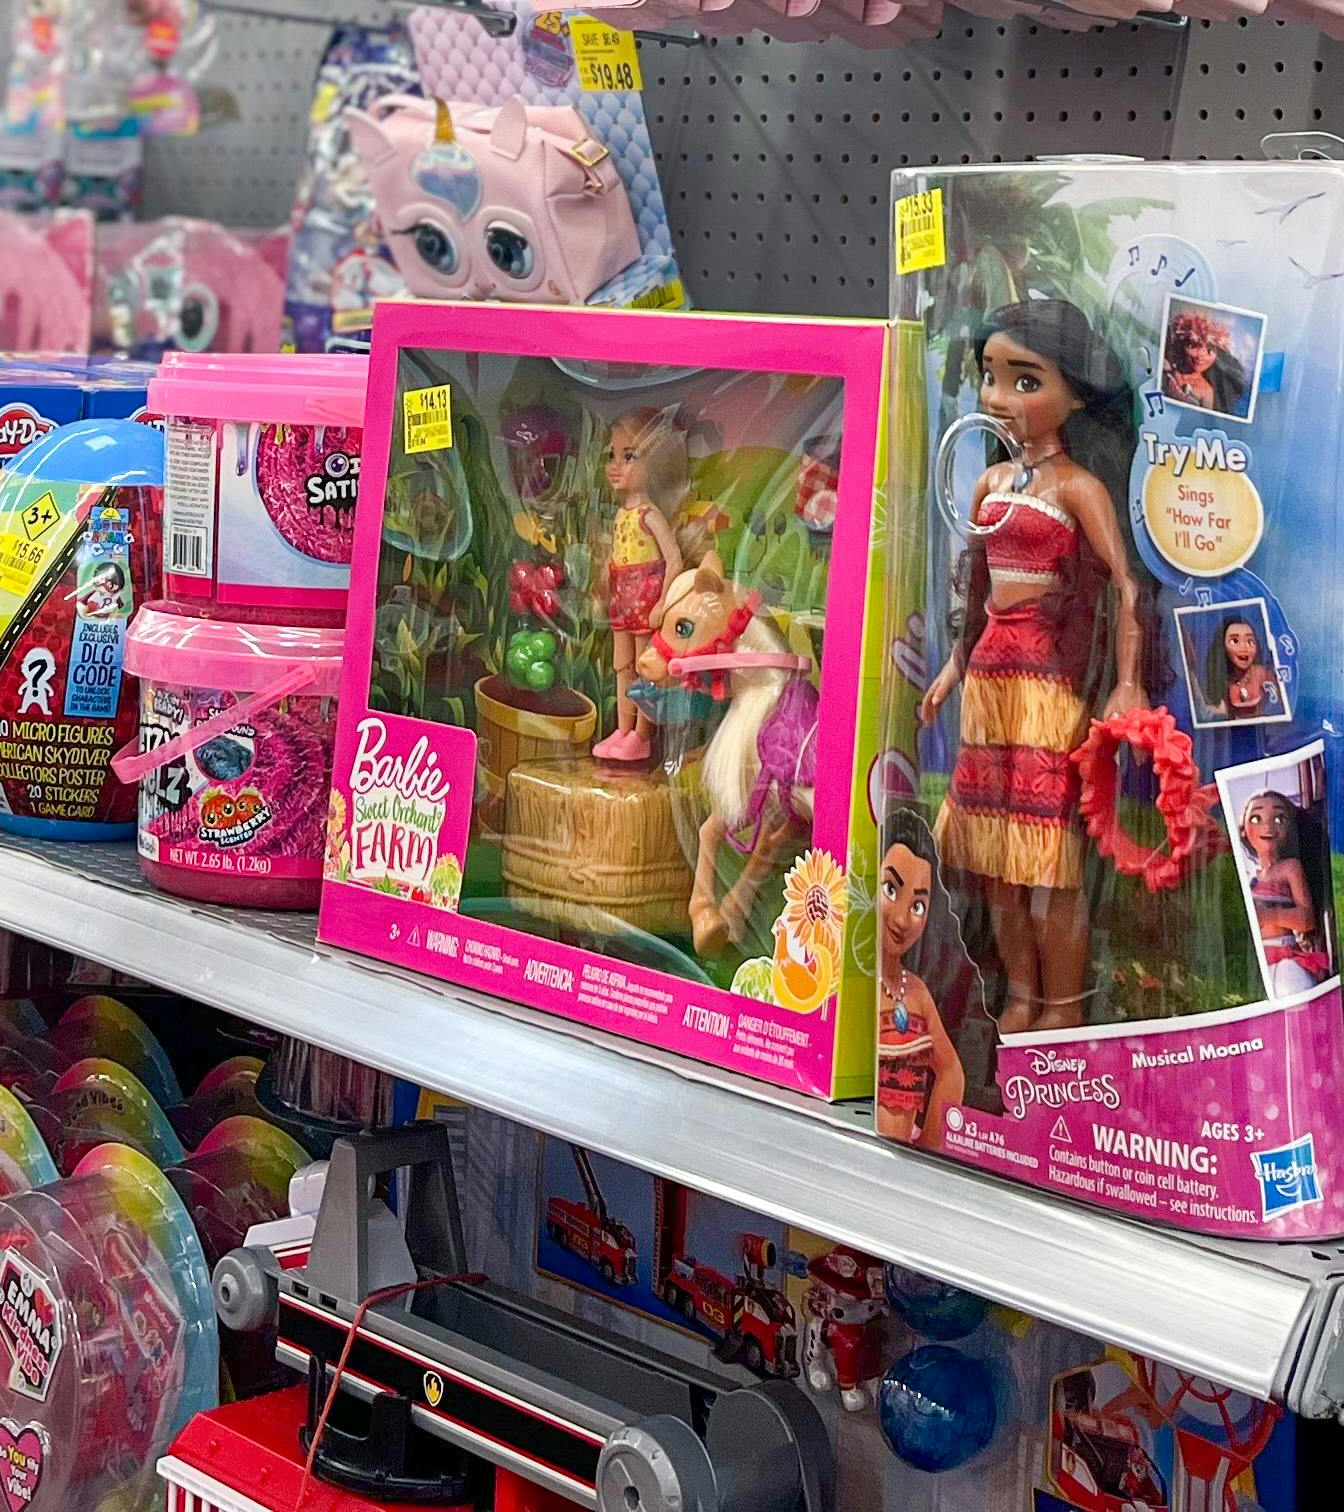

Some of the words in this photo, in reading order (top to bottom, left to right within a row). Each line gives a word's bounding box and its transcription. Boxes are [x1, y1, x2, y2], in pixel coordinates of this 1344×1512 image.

[590, 62, 634, 91] $19.48
[419, 388, 447, 411] $14.13
[1141, 431, 1191, 477] Try
[1194, 436, 1248, 473] Me
[1177, 484, 1215, 508] Sings
[27, 506, 53, 525] 3+
[1166, 506, 1204, 526] "How
[1207, 511, 1232, 529] Far
[12, 536, 45, 564] $15.66
[1174, 530, 1191, 549] I'll
[1194, 534, 1223, 552] Go"
[81, 642, 114, 666] DLC
[72, 664, 118, 688] CODE
[11, 720, 57, 743] MICRO
[57, 724, 115, 747] FIGURES
[44, 745, 111, 767] SKYDIVER
[349, 717, 451, 803] Barbie
[58, 768, 106, 786] POSTER
[26, 783, 42, 799] 20
[44, 784, 99, 804] STICKERS
[38, 801, 66, 816] GAME
[67, 802, 96, 818] CARD
[199, 805, 272, 839] STRAWBERRY
[355, 795, 391, 824] Sweet
[392, 793, 442, 836] Orchard
[169, 848, 183, 864] NET
[184, 850, 200, 866] WT.
[201, 852, 221, 869] 2.65
[222, 855, 235, 870] lb.
[236, 856, 272, 874] (1.2kg)
[355, 821, 434, 881] FARM
[1131, 1044, 1195, 1069] Musical
[1199, 1037, 1264, 1062] Moana
[1005, 1073, 1121, 1120] PRINCESS
[1200, 1120, 1241, 1142] AGES
[1243, 1124, 1265, 1143] 3+
[1091, 1122, 1219, 1176] WARNING:
[1048, 1144, 1088, 1170] Contains
[1088, 1153, 1122, 1178] button
[1122, 1167, 1134, 1181] or
[1134, 1169, 1156, 1187] coin
[1157, 1172, 1176, 1192] cell
[1176, 1175, 1220, 1201] battery.
[1261, 1160, 1316, 1184] Hasbro
[1047, 1166, 1096, 1193] Hazardous
[1096, 1176, 1106, 1196] if
[1105, 1182, 1158, 1208] swallowed
[1169, 1197, 1189, 1213] see
[1189, 1199, 1259, 1224] instructions.
[7, 1279, 50, 1355] EMMA
[701, 1300, 726, 1325] 03
[1, 1300, 50, 1378] Kindness
